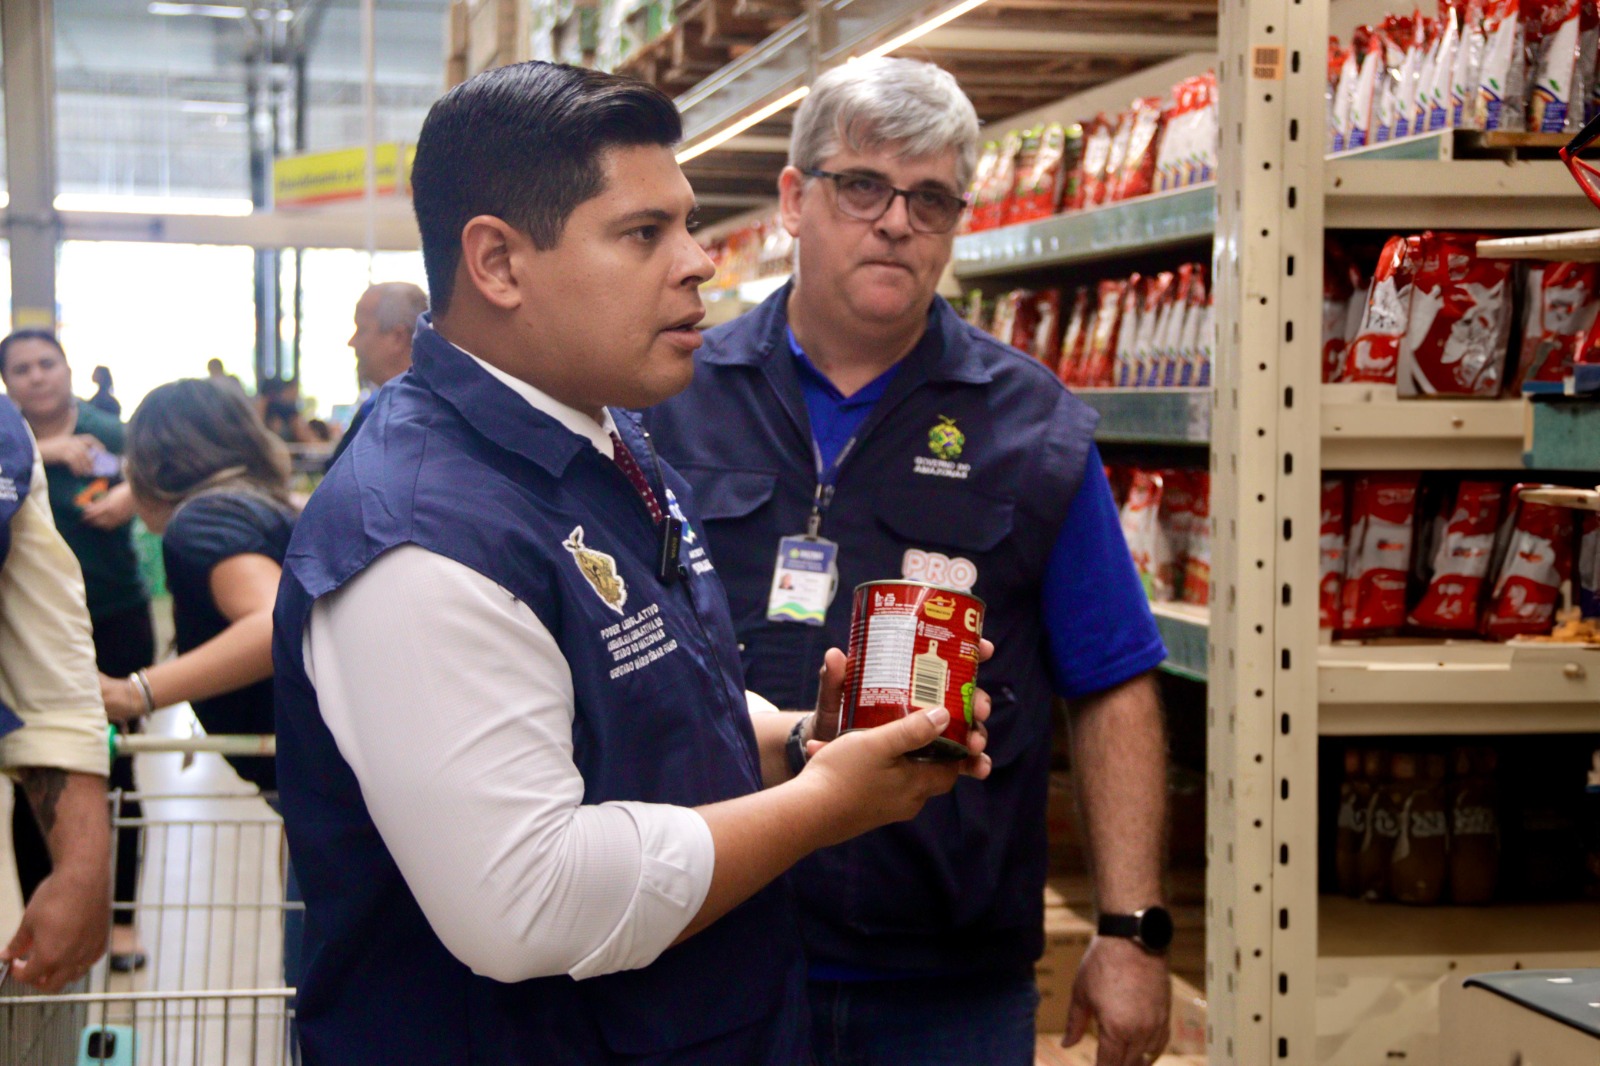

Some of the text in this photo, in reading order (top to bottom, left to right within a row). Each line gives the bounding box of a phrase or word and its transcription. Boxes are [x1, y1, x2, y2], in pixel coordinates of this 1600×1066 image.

[913, 456, 971, 472] GOVERNO DO
[913, 465, 968, 479] AMAZONAS
[903, 549, 977, 588] PRO
[600, 603, 659, 640] PODER LEGISLATIVO
